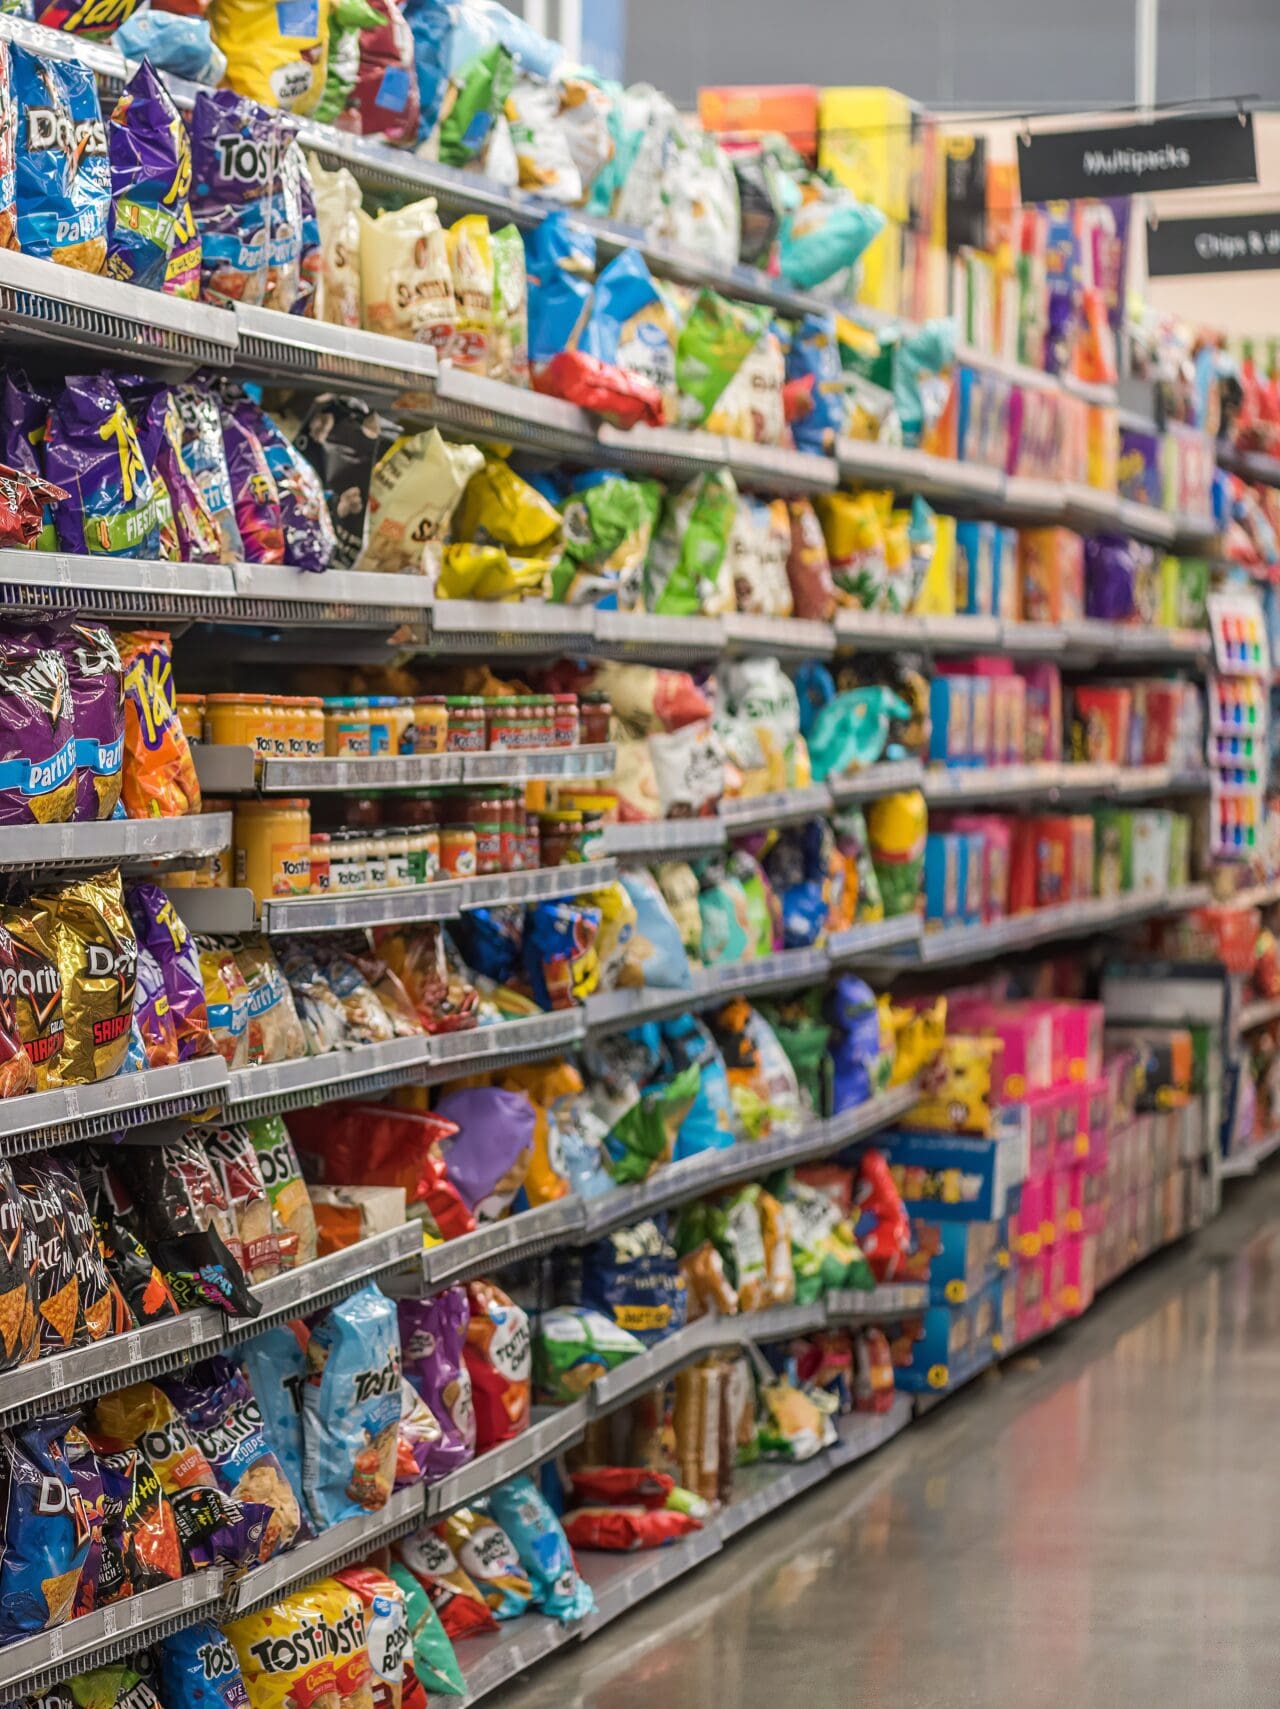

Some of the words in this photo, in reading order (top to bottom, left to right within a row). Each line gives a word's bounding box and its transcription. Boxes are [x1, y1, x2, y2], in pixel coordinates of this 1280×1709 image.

[1082, 144, 1191, 177] Multipacks
[29, 747, 68, 789] Party
[18, 964, 61, 996] orit
[354, 1360, 401, 1404] Tosti
[233, 1435, 266, 1468] SCOOPS
[250, 1614, 327, 1677] Tostit
